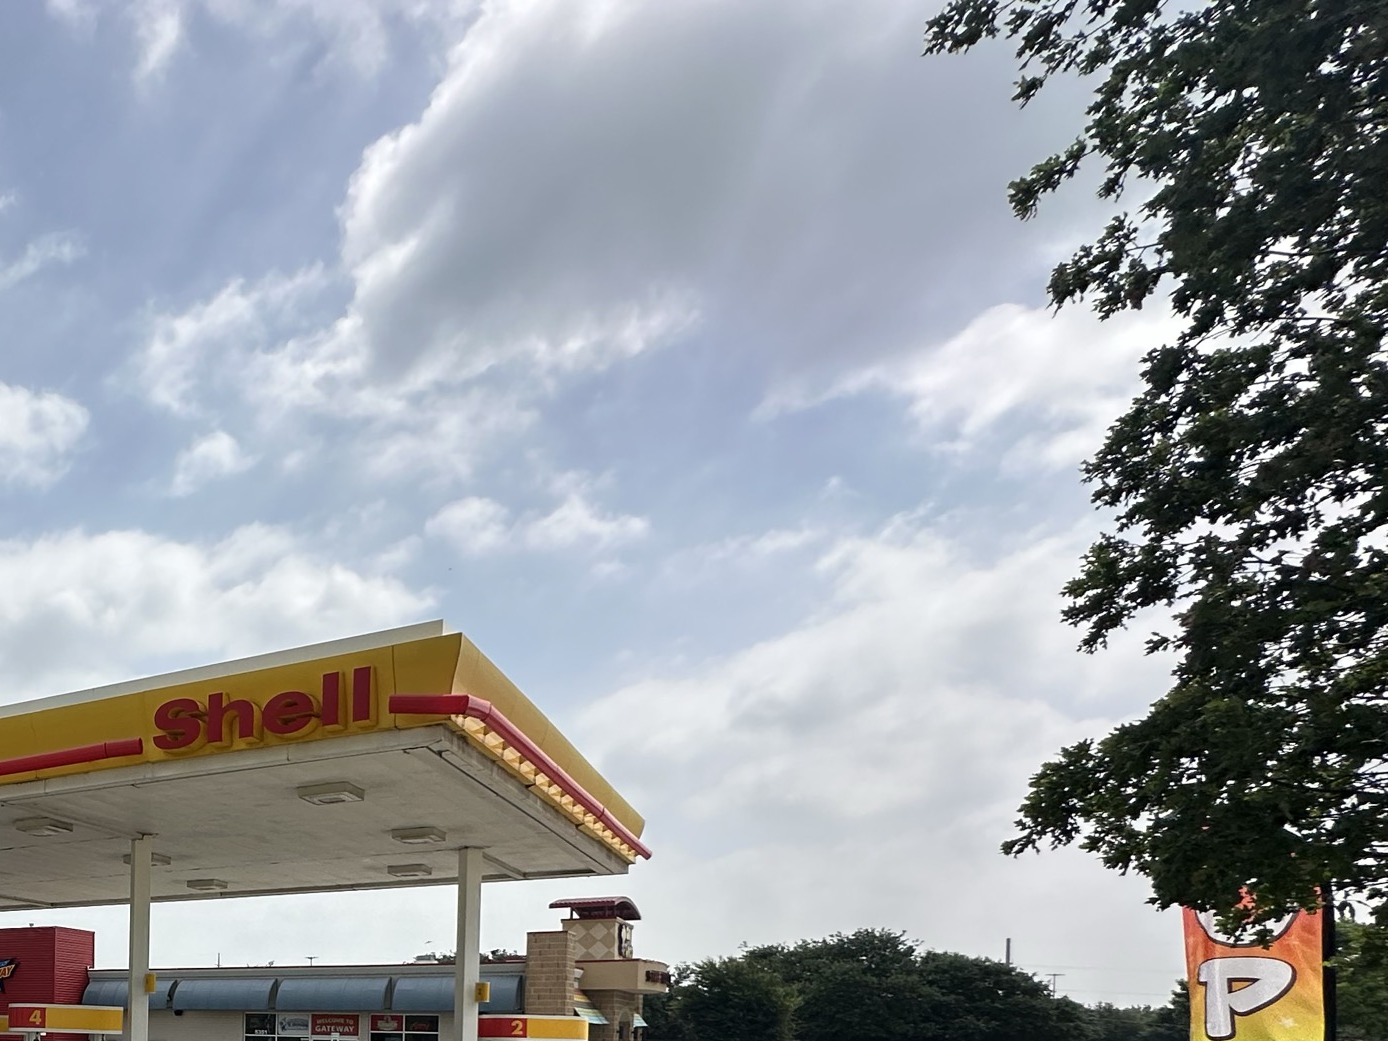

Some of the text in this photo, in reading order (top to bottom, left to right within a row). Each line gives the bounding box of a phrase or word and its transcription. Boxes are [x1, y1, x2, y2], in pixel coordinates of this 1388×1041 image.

[153, 665, 373, 750] shell
[29, 1010, 42, 1024] 4
[315, 1025, 354, 1033] GATEWAY
[511, 1020, 523, 1035] 2
